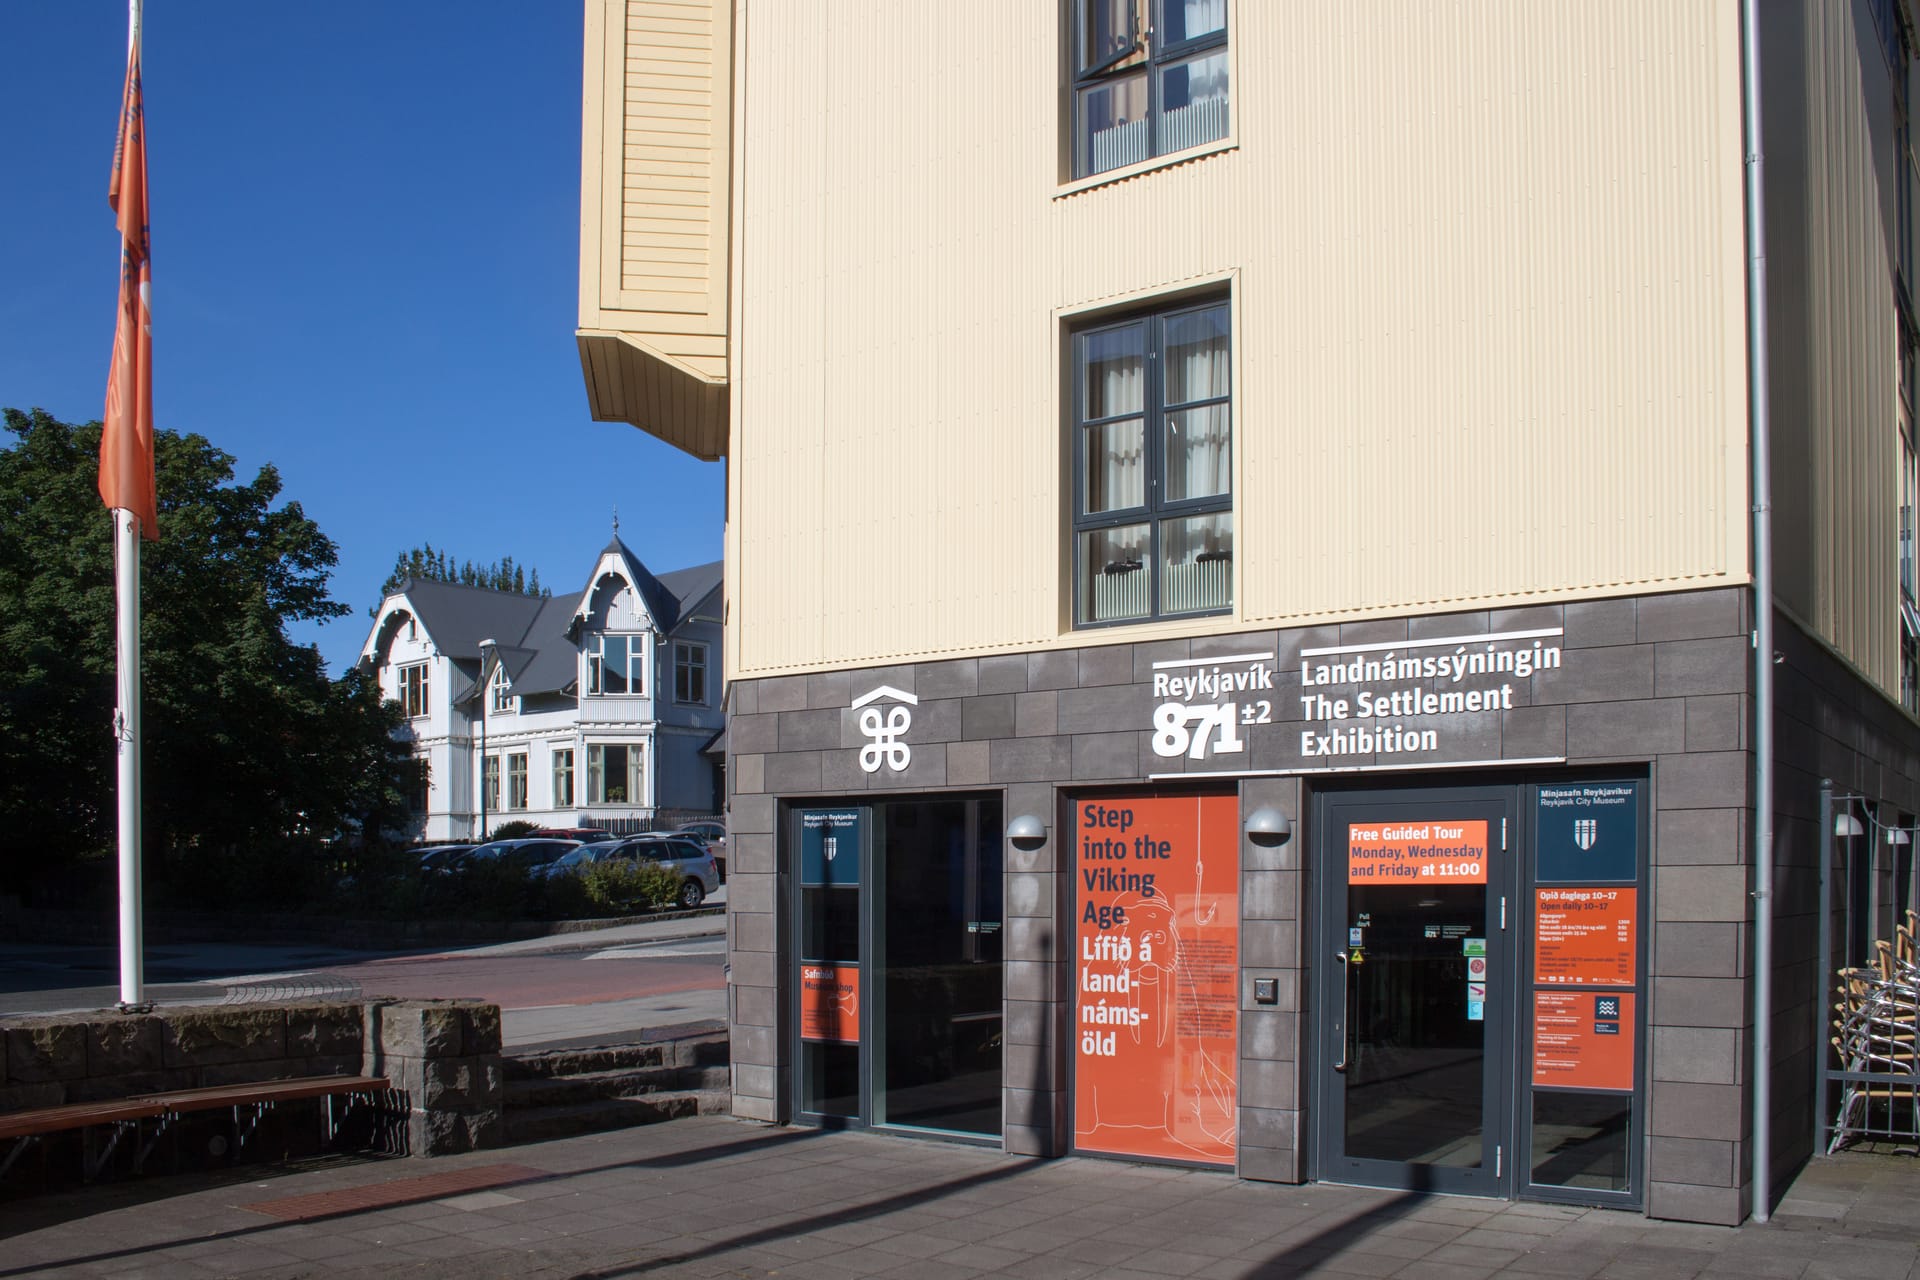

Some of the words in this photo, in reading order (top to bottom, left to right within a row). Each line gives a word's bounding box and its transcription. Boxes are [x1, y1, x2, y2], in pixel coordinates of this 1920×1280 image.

[1301, 640, 1560, 687] Landnámssýningin
[1153, 663, 1273, 702] Reykjavík
[1300, 693, 1349, 721] The
[1356, 683, 1513, 718] Settlement
[1301, 724, 1438, 756] Exhibition
[1575, 797, 1591, 807] City
[1083, 804, 1134, 833] Step
[1350, 828, 1379, 841] Free
[1382, 826, 1429, 841] Guided
[1432, 825, 1464, 839] Tour
[1082, 835, 1127, 860] into
[1134, 834, 1171, 859] the
[1351, 846, 1405, 861] Monday,
[1407, 844, 1484, 860] Wednesday
[1083, 866, 1156, 898] Viking
[1351, 864, 1375, 876] and
[1378, 863, 1419, 879] Friday
[1421, 863, 1436, 876] at
[1438, 862, 1481, 876] 11:00
[1082, 900, 1125, 930] Age
[1540, 902, 1561, 911] Open
[1562, 901, 1582, 911] daily
[1083, 935, 1133, 962] Lífið
[1139, 935, 1153, 962] á
[1082, 966, 1140, 993] land-
[1082, 998, 1149, 1026] náms-
[1081, 1030, 1117, 1057] öld
